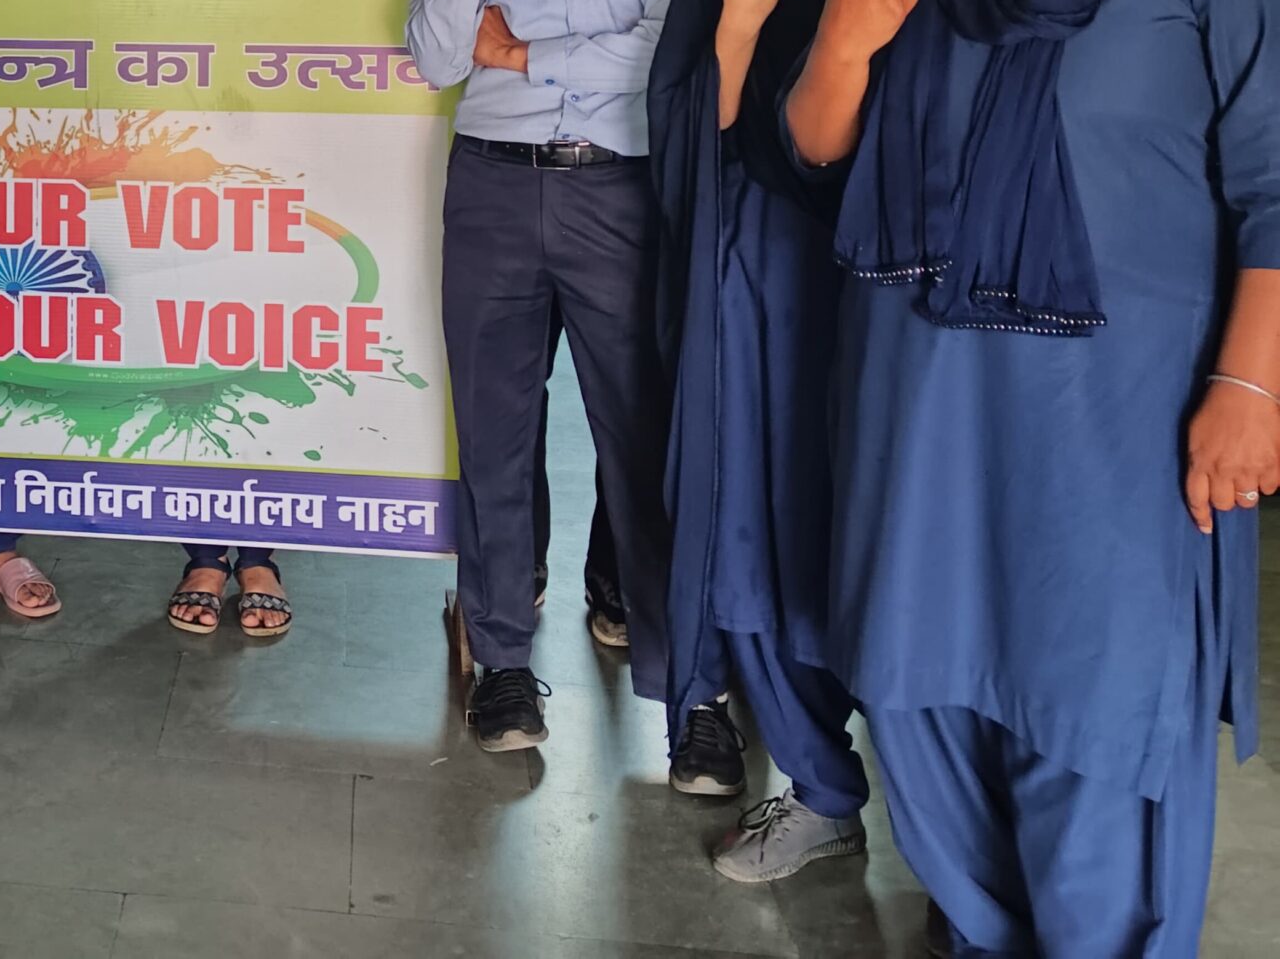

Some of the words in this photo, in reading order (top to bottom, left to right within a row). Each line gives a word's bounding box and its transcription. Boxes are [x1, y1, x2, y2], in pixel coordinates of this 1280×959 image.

[114, 43, 216, 87] का
[119, 183, 306, 253] VOTE
[156, 298, 385, 372] VOICE
[14, 469, 156, 519] निर्वाचन
[163, 479, 327, 528] कार्यालय
[336, 496, 439, 535] नाहन
